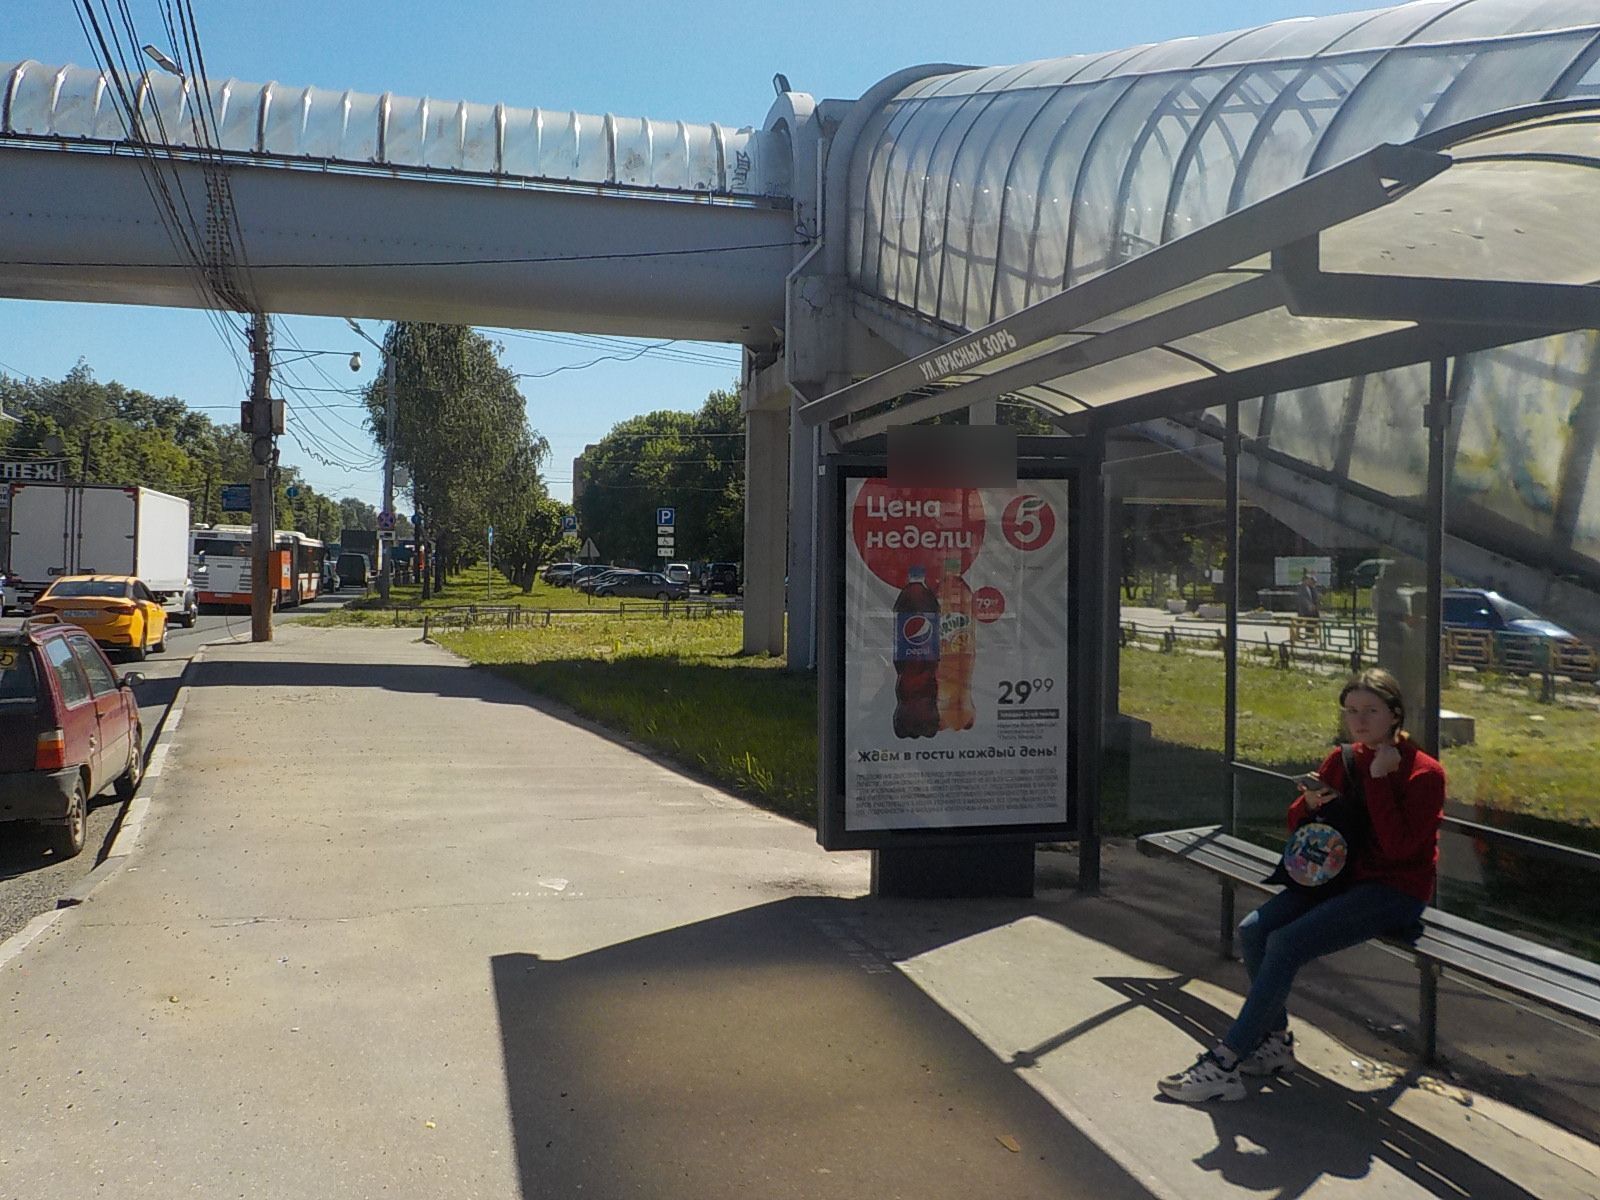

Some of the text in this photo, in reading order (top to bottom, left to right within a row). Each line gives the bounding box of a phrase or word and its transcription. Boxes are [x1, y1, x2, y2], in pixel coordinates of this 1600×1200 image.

[919, 329, 1017, 380] УЛ. КРАСНЫХ ЗОРЬ
[661, 510, 672, 524] P
[867, 495, 941, 521] Цена
[867, 525, 972, 548] недели
[858, 745, 1057, 762] Ждём в гости каждый день!
